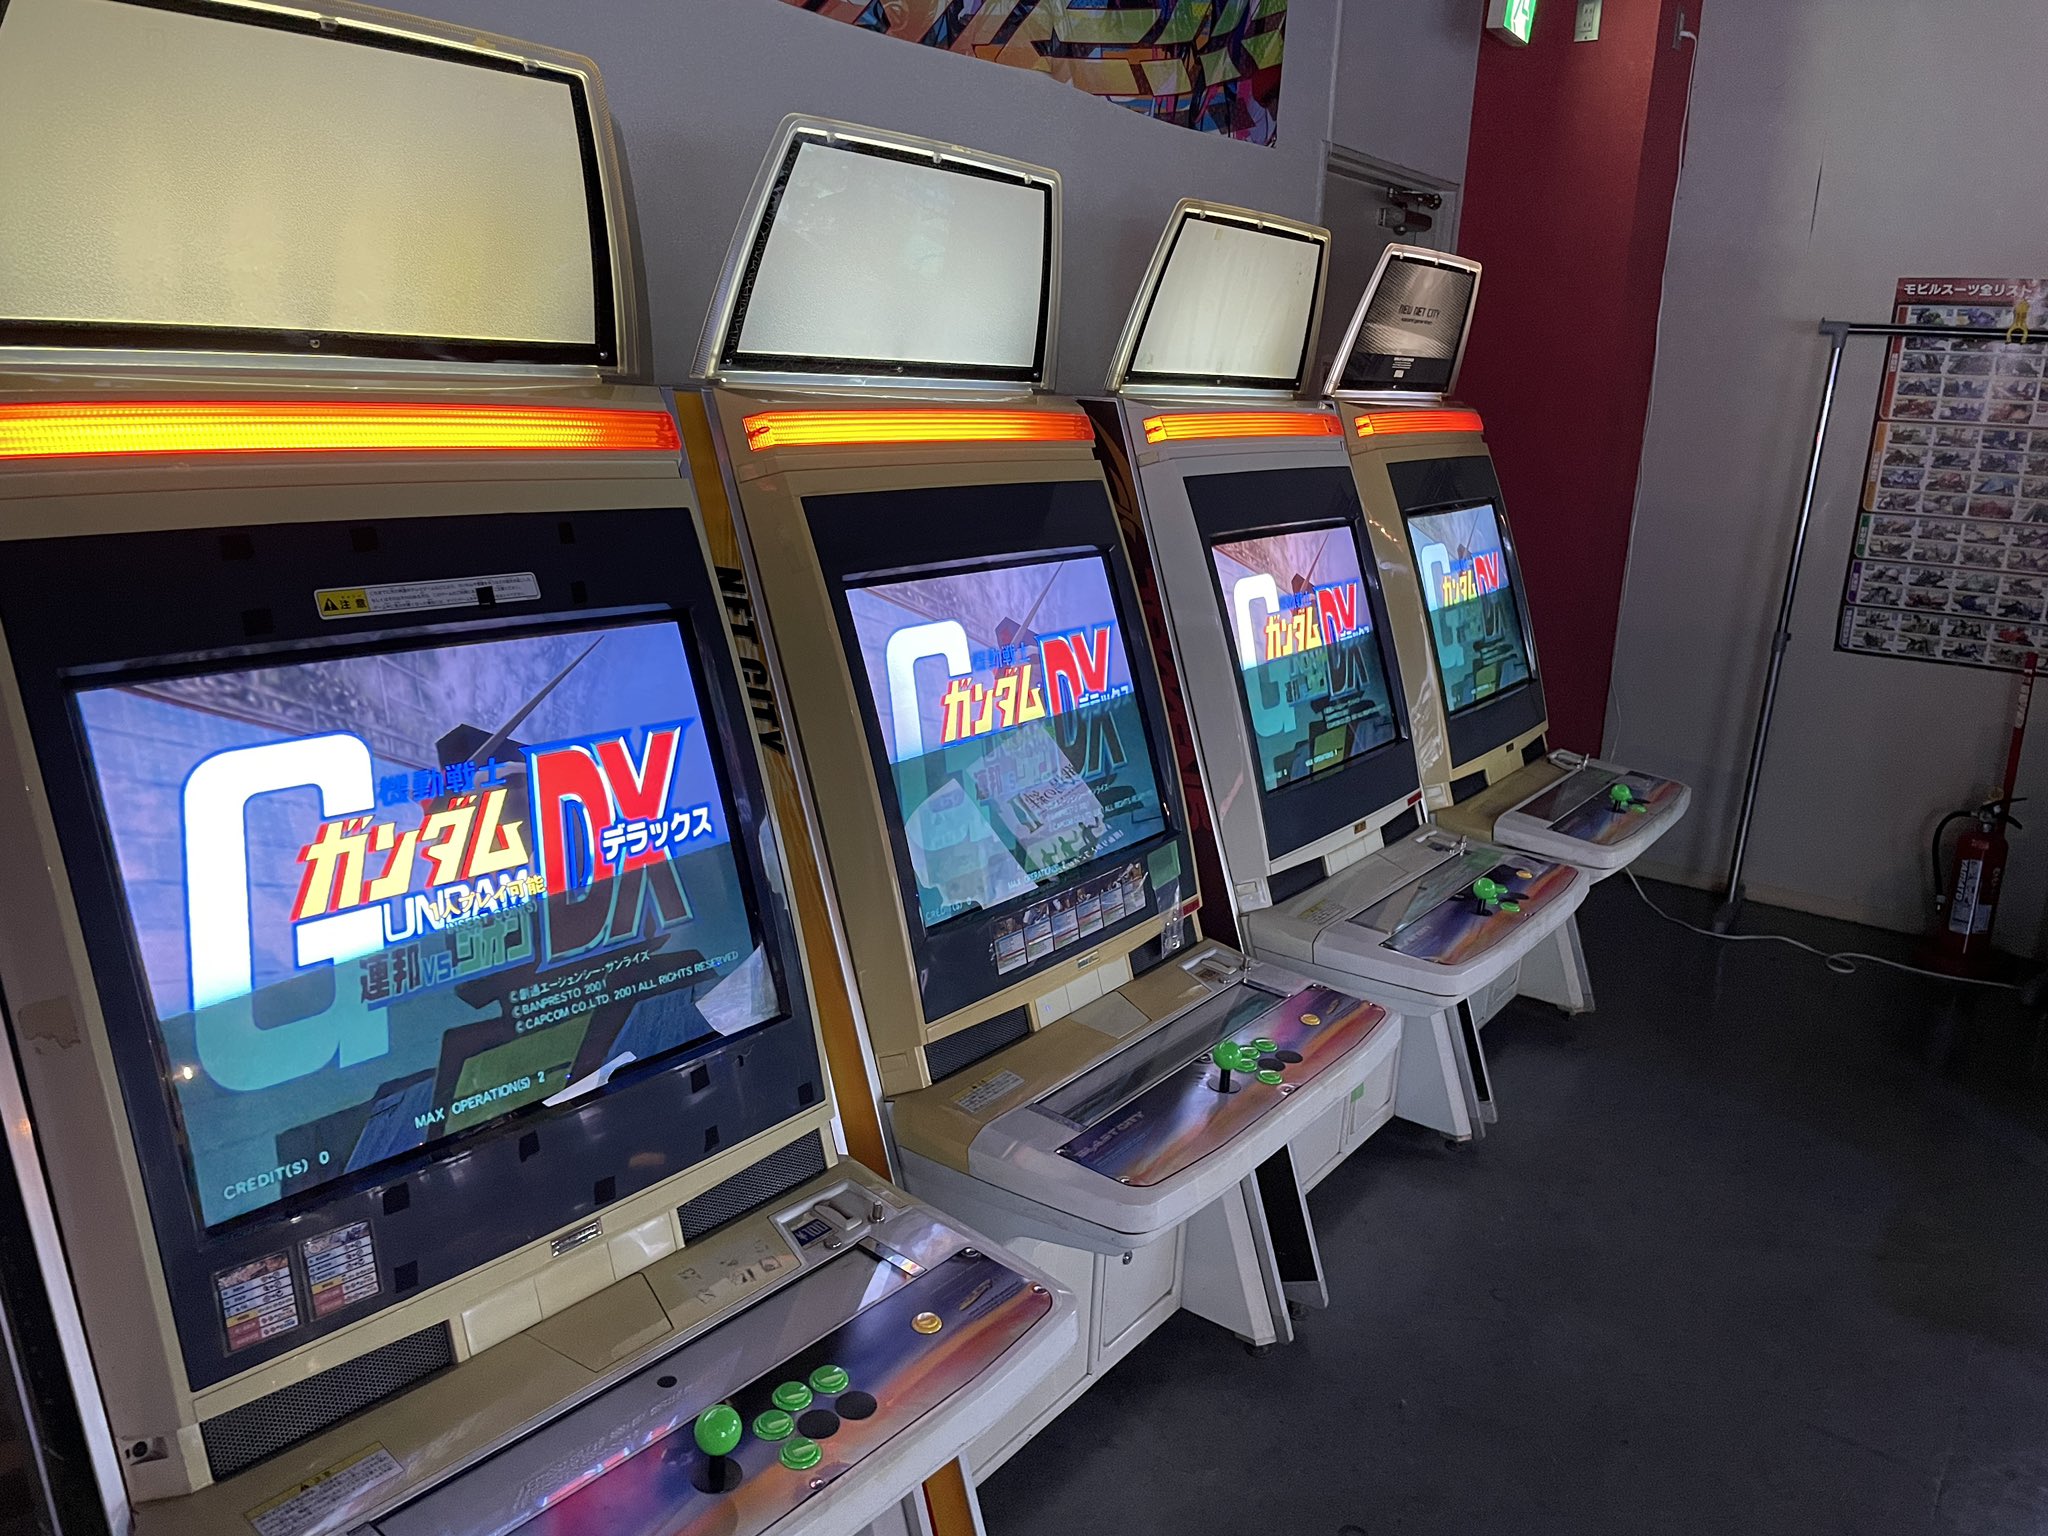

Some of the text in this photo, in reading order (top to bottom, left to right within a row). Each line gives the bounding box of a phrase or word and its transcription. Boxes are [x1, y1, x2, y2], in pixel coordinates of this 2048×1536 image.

[1413, 306, 1426, 317] NET
[1427, 308, 1441, 319] CITY
[1904, 283, 2033, 298] モビルスーツ全リスト
[339, 597, 368, 611] 注意
[714, 566, 786, 755] NET CITY
[1264, 605, 1322, 661] ガンダム
[940, 663, 1047, 745] ガンダム
[289, 787, 530, 922] ガンダム
[526, 724, 694, 963] DX
[601, 806, 713, 862] デラックス
[658, 965, 693, 984] RIGHTS
[414, 1070, 546, 1130] MAX OPERATION(S) 2
[223, 1160, 309, 1200] CREDIT(S)
